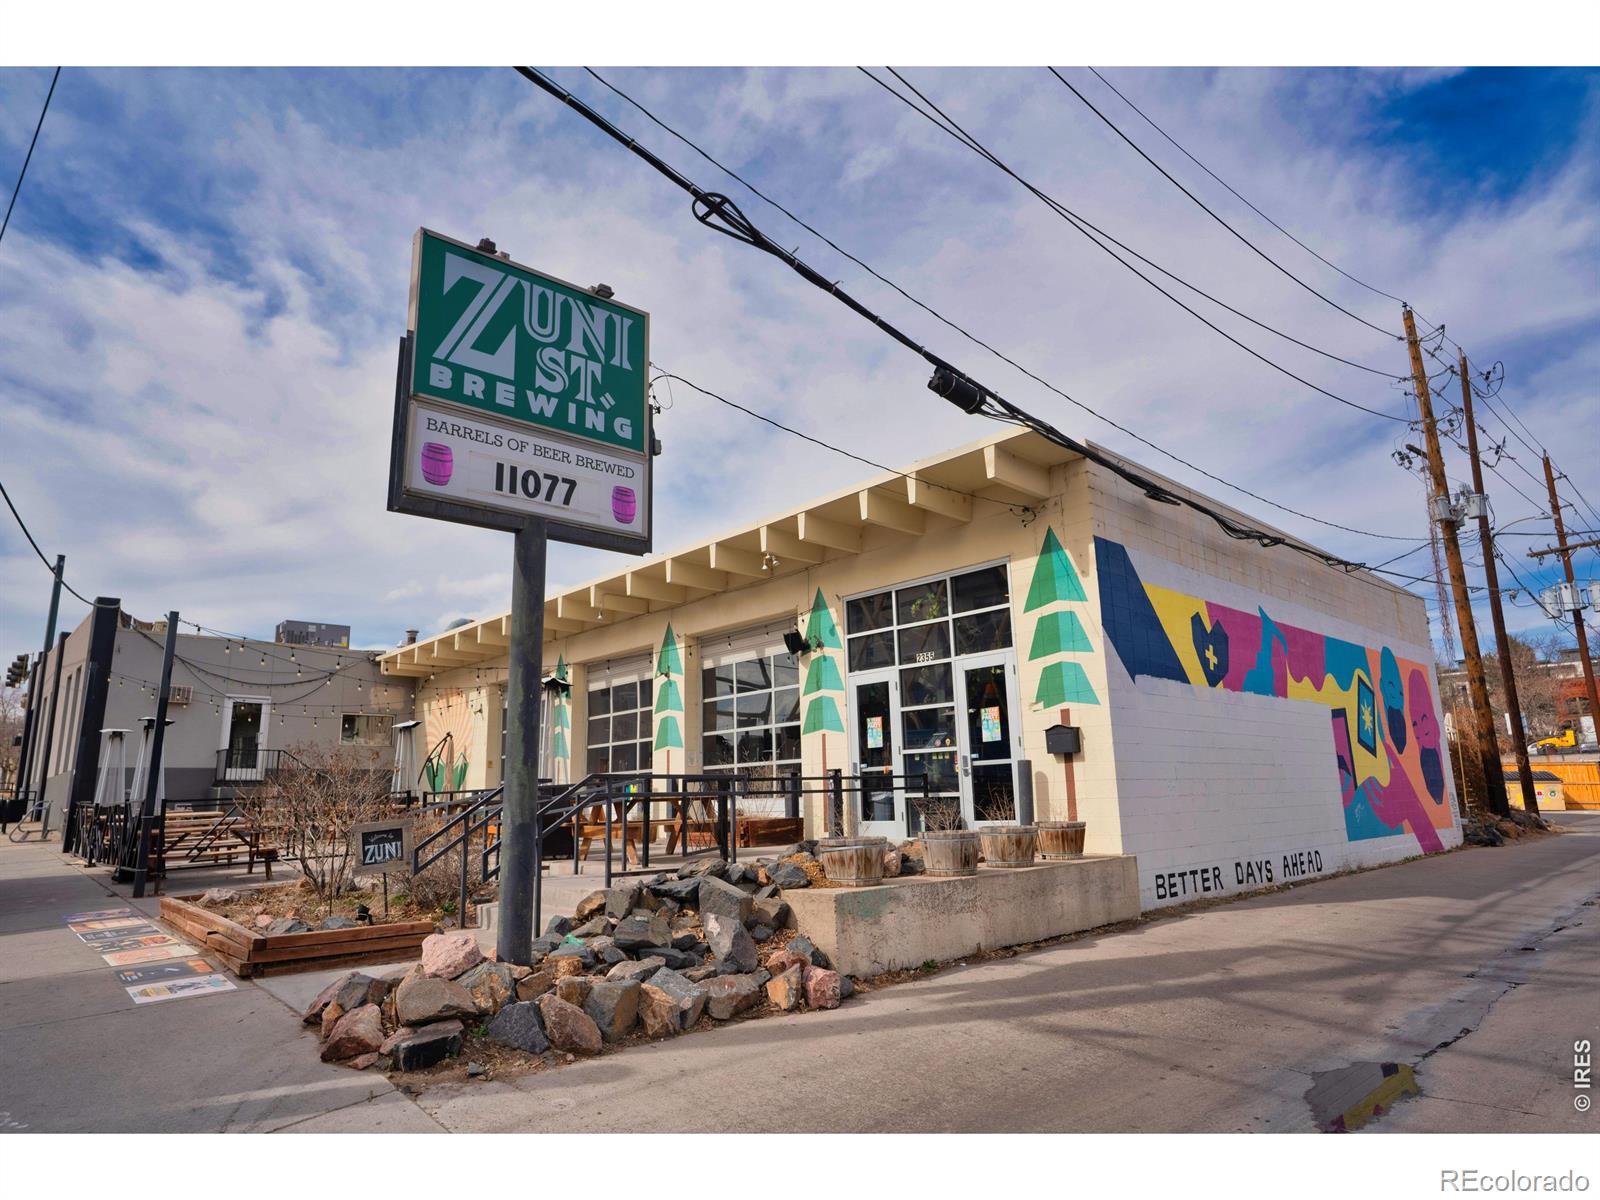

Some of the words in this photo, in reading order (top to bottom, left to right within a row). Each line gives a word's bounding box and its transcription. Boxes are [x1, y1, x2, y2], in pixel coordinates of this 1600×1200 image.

[432, 252, 634, 380] ZUNI
[429, 363, 633, 440] BREWING
[535, 347, 615, 409] ST.
[426, 417, 503, 447] BARRELS
[508, 437, 528, 453] OF
[532, 444, 572, 464] BEER
[575, 455, 635, 478] BREWED
[495, 462, 578, 506] 11077
[916, 651, 935, 663] 2355
[365, 841, 402, 864] ZUNI
[1155, 866, 1224, 900] BETTER
[1235, 860, 1273, 885] DAYS
[1283, 850, 1323, 878] AHEAD
